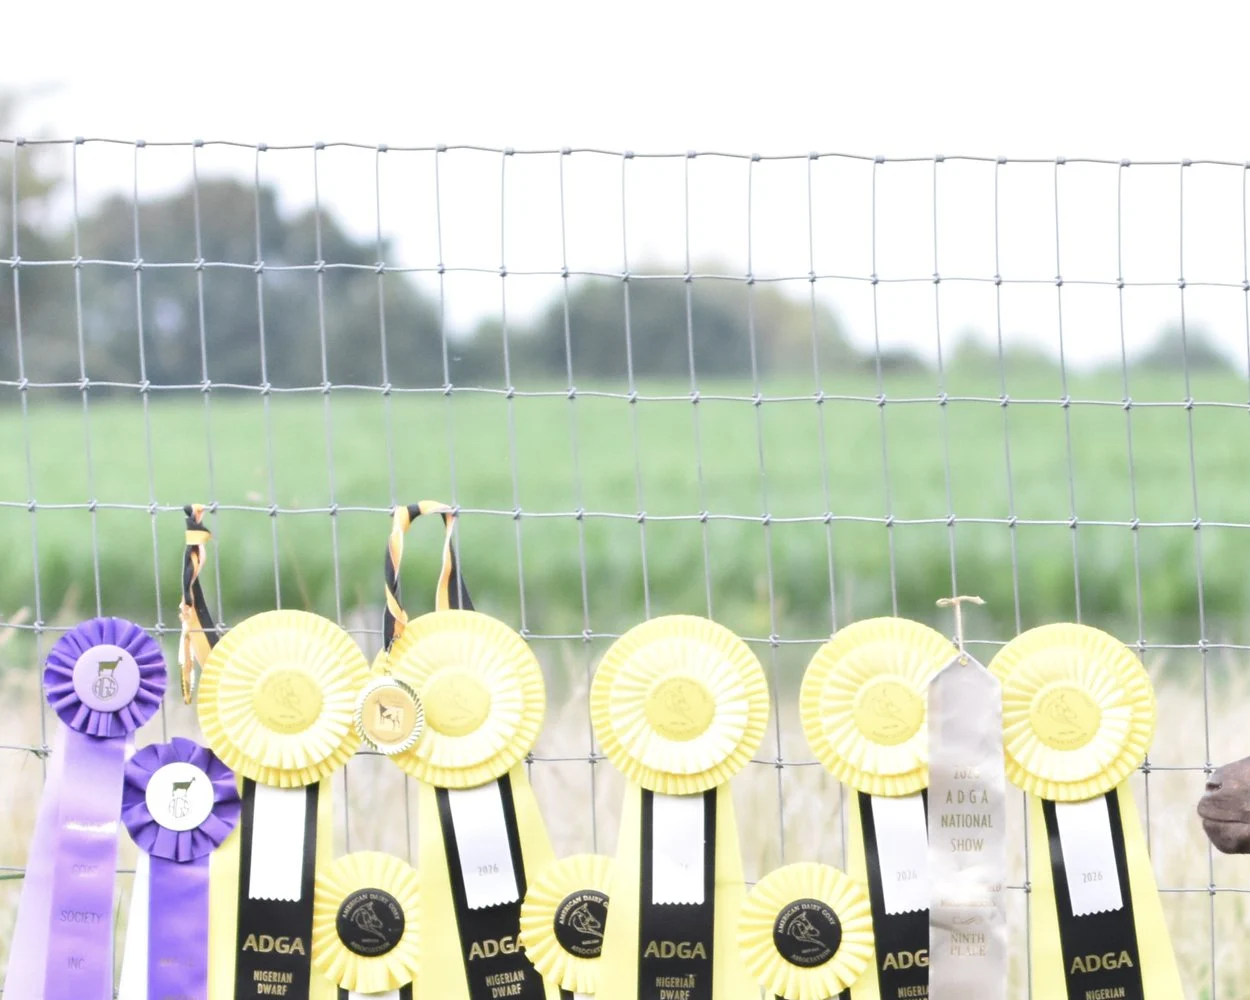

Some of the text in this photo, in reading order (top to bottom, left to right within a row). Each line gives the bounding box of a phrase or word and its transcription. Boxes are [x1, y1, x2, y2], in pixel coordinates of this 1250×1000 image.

[941, 814, 993, 829] NATIONAL
[950, 839, 984, 852] SHOW
[1082, 871, 1103, 883] 2026
[342, 893, 368, 919] AMERICAN
[559, 896, 582, 925] AMERICAN
[582, 895, 603, 904] DAIRY
[60, 910, 103, 924] SOCIETY
[778, 903, 836, 934] AMERICAN DAIRY GOAT
[242, 933, 306, 955] ADGA
[950, 932, 986, 943] NINTH
[643, 940, 707, 960] ADGA
[1070, 950, 1133, 975] ADGA
[253, 970, 293, 983] NIGERIAN
[485, 969, 525, 987] NIGERIAN
[655, 976, 695, 988] NIGERIAN
[257, 982, 288, 996] DWARF
[492, 983, 522, 999] DWARF
[660, 990, 690, 1000] DWARF
